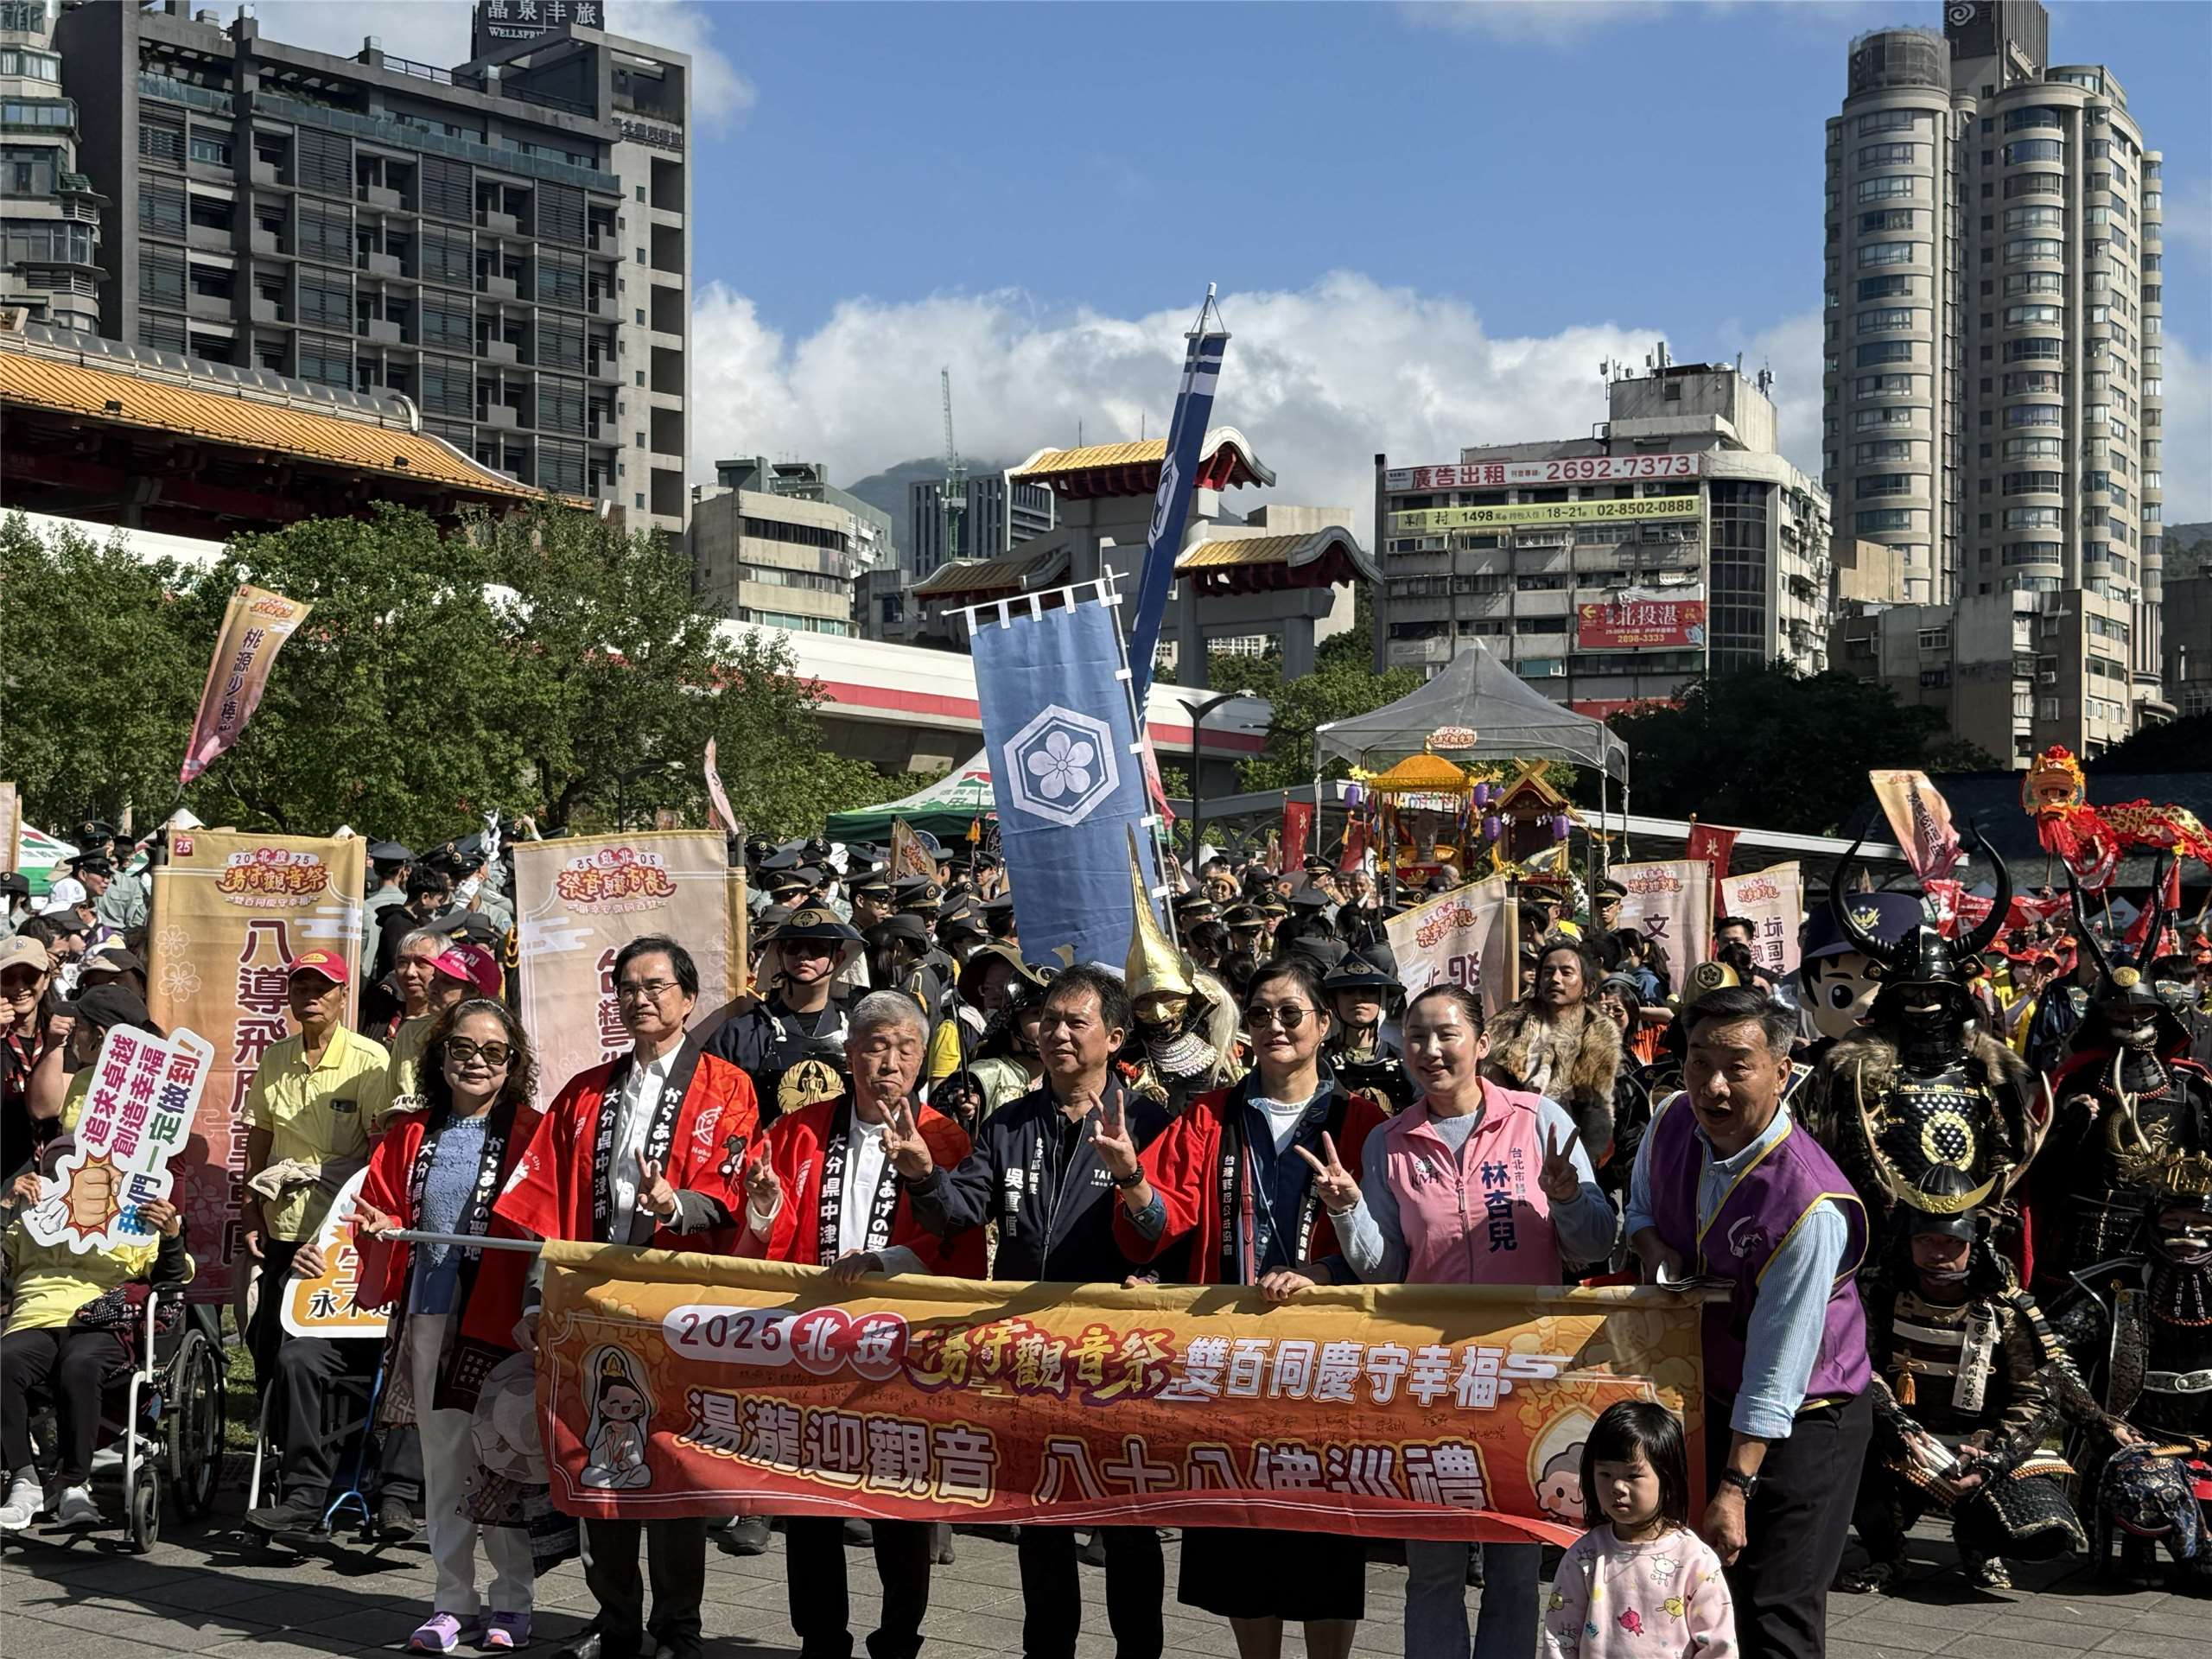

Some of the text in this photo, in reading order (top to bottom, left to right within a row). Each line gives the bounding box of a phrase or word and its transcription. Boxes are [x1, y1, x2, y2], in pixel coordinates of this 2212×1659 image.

[487, 0, 596, 25] 晶泉丰旅
[487, 26, 544, 40] WELLSPR
[1412, 465, 1505, 489] 廣告出租
[1546, 455, 1691, 480] 2692-7373
[1597, 499, 1694, 517] 02-8502-0888
[175, 841, 192, 853] 25
[296, 854, 311, 864] 25
[81, 1033, 137, 1147] 追求卓越
[111, 1044, 167, 1159] 創造幸福
[819, 1134, 847, 1267] 大分県中津市
[1480, 1160, 1518, 1253] 林杏兒
[679, 1313, 782, 1351] 2025
[798, 1316, 900, 1367] 北投
[907, 1319, 1169, 1401] 湯守觀音祭
[1179, 1336, 1504, 1409] 雙百同慶守幸福
[677, 1391, 1485, 1510] 湯瀧迎觀音 八十八佛巡禮
